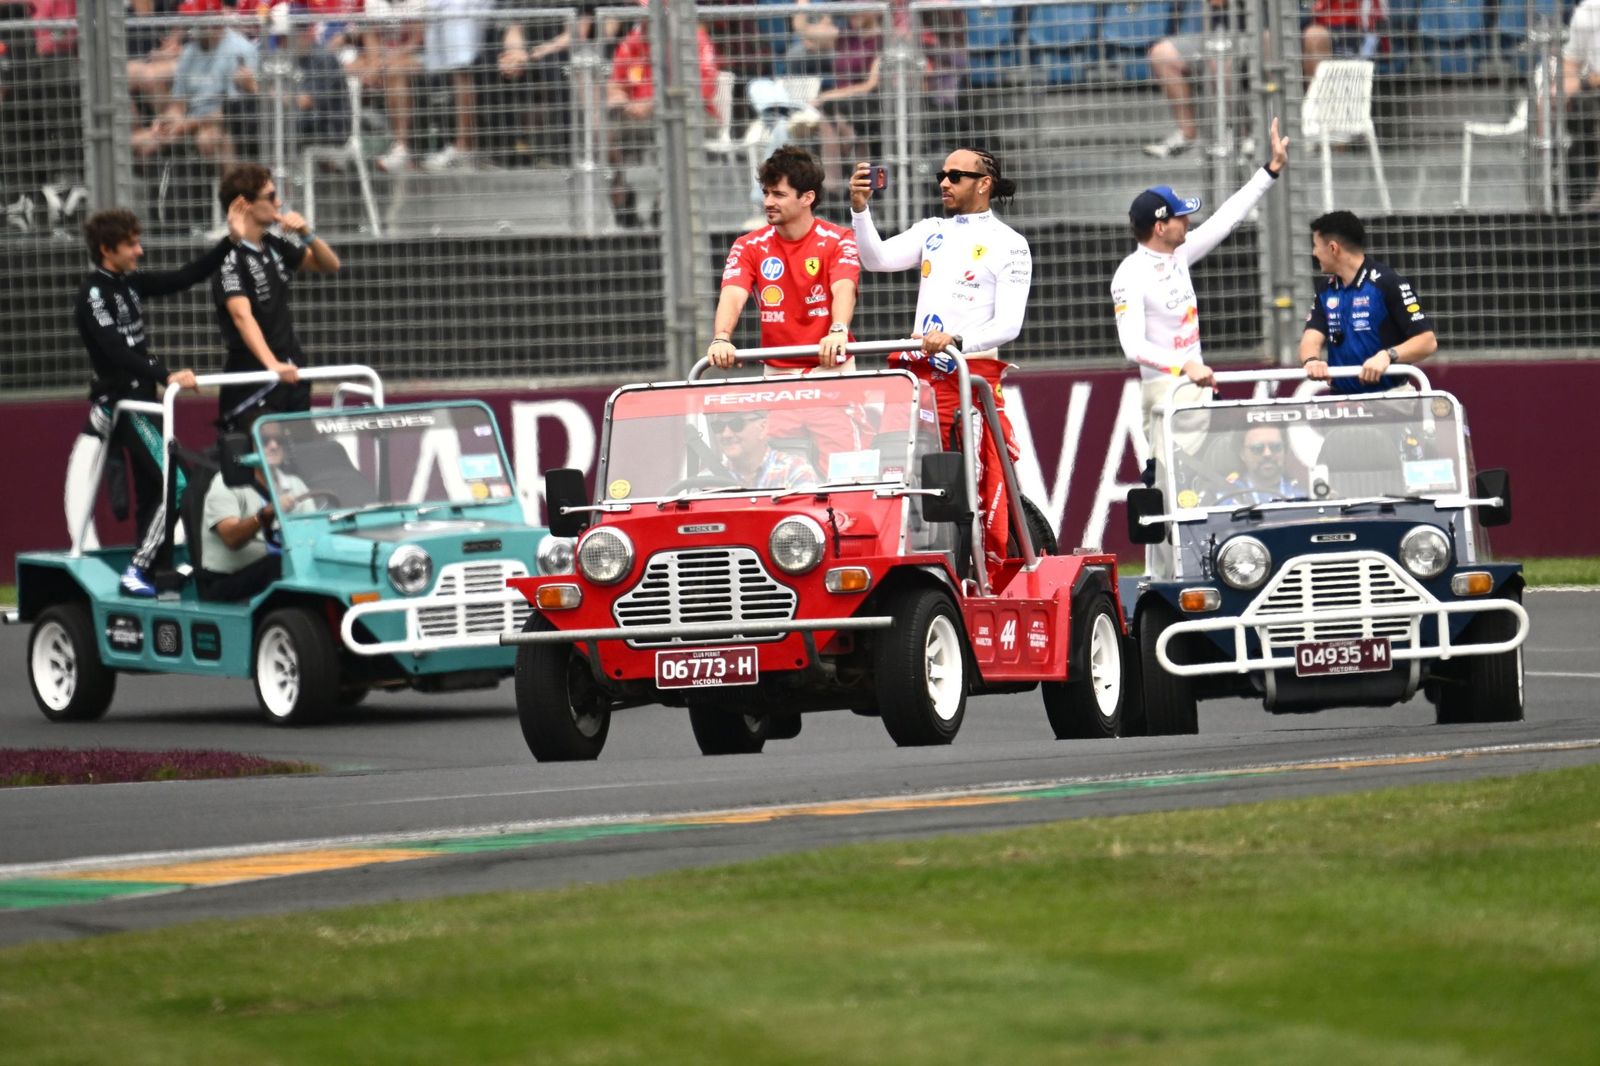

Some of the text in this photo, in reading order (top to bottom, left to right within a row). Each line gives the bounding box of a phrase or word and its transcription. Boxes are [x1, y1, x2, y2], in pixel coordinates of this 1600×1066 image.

[762, 257, 783, 280] hp
[761, 311, 784, 323] IBM
[704, 389, 820, 406] FERRARI
[1247, 406, 1374, 423] RED BULL
[315, 414, 436, 434] MERCEDES
[1000, 620, 1016, 650] 44
[692, 678, 723, 686] VICTORIA
